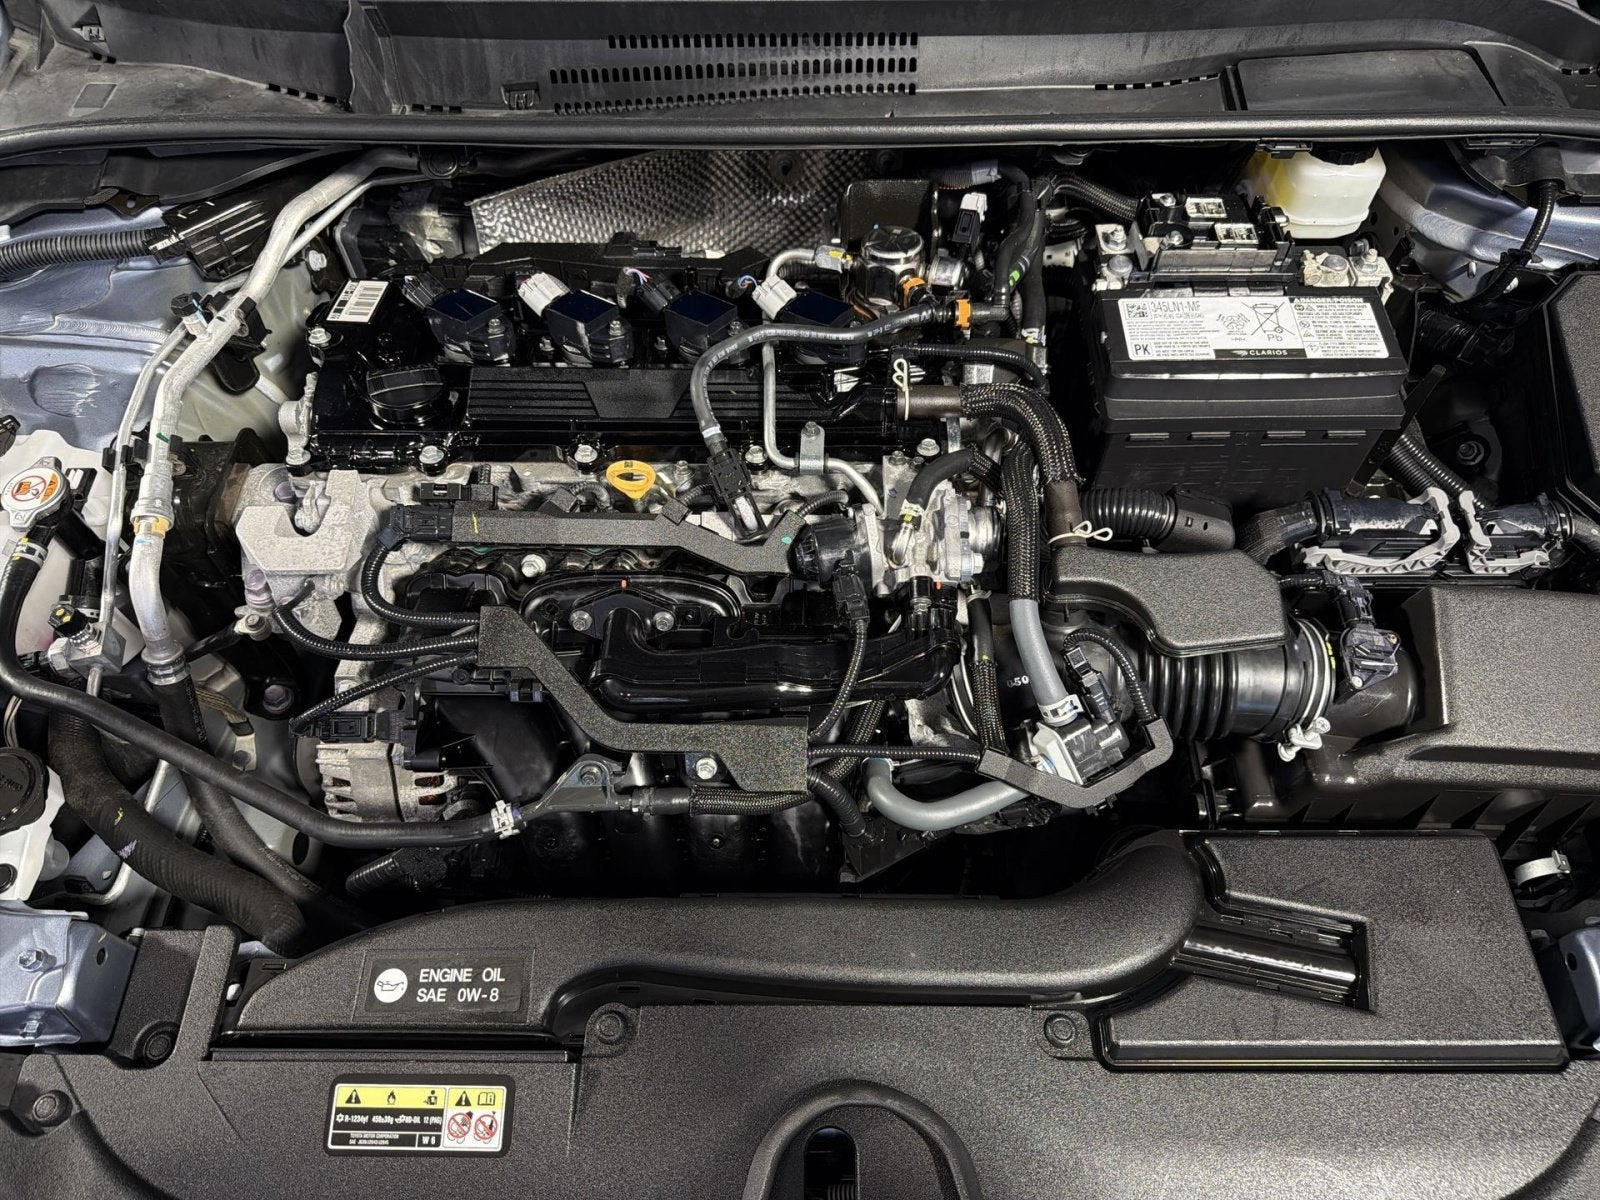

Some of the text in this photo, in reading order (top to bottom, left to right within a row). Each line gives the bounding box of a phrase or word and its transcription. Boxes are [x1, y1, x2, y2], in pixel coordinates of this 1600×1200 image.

[1150, 300, 1201, 313] 345LN1-MF
[1266, 333, 1283, 342] Pb
[1134, 343, 1151, 356] PK
[419, 967, 506, 982] ENGINE OIL
[416, 987, 500, 1003] SAE 0W-8
[422, 1135, 436, 1145] W 6
